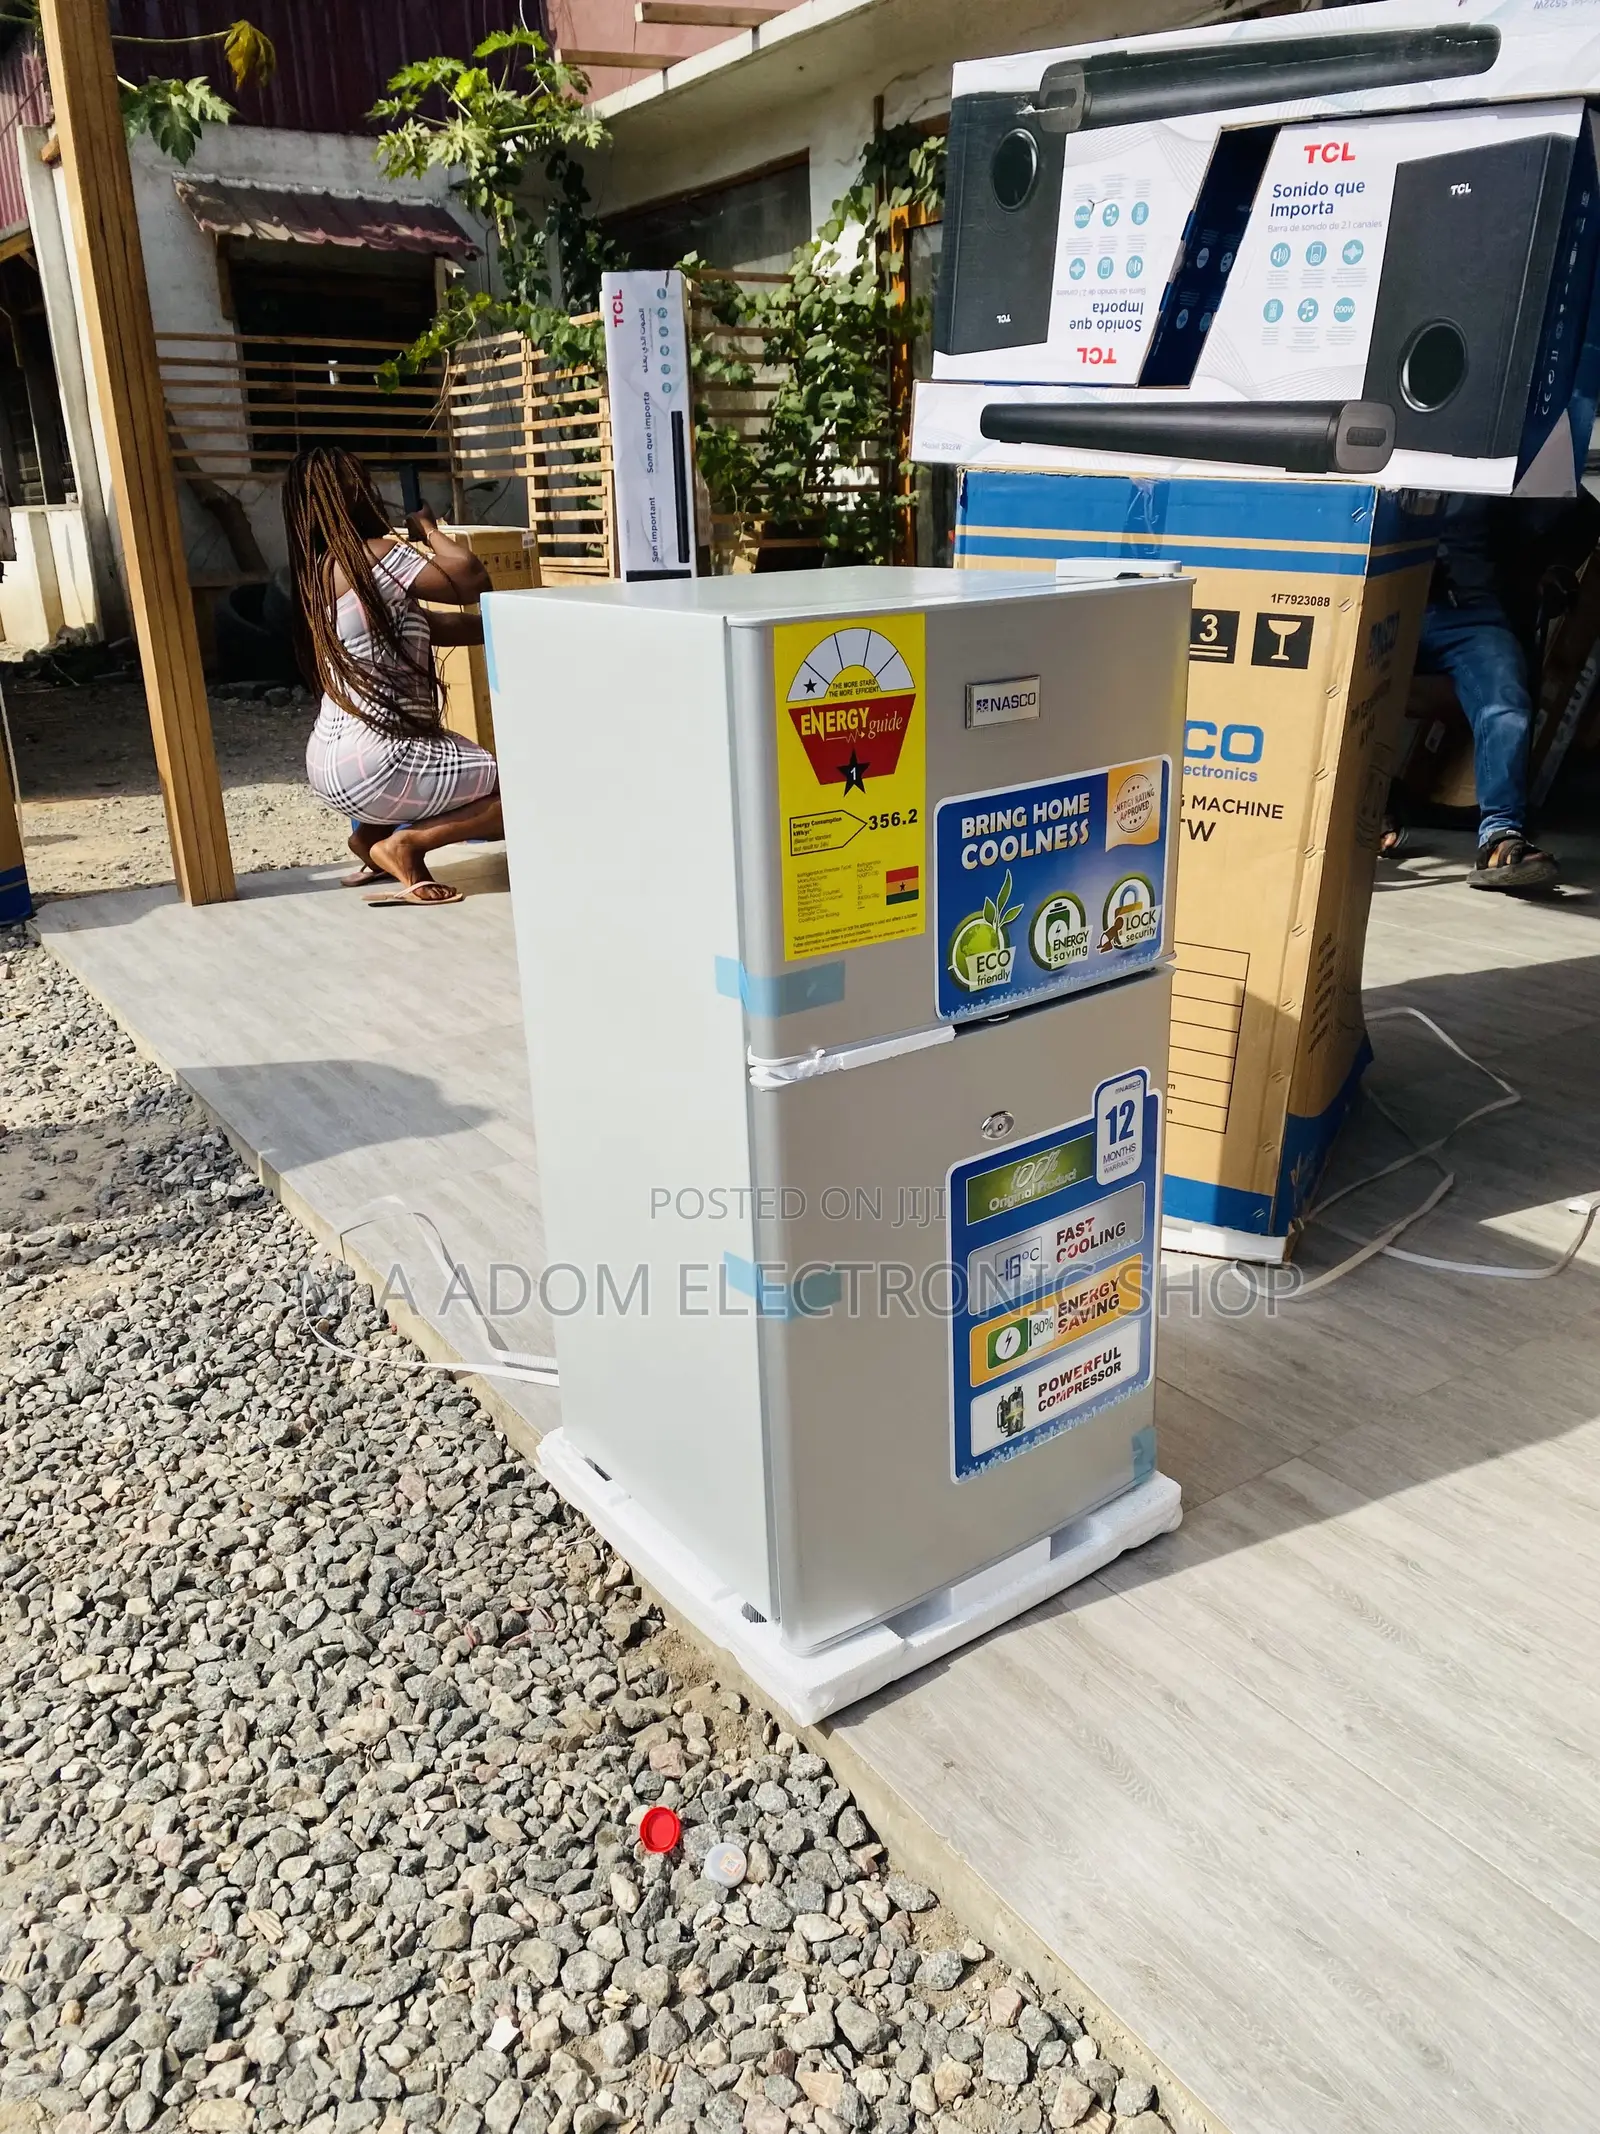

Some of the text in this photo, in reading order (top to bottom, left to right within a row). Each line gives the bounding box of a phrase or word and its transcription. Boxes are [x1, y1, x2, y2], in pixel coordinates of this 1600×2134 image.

[1303, 142, 1356, 164] TCL
[1272, 181, 1366, 198] Sonido que
[1450, 182, 1472, 196] TCL
[1270, 201, 1334, 219] Importa
[1267, 224, 1288, 233] Barra
[1289, 222, 1300, 232] de
[1301, 222, 1327, 231] sonido
[1352, 220, 1383, 229] canales
[613, 289, 624, 328] TCL
[1092, 301, 1144, 315] Importa
[1069, 318, 1142, 332] Sonido que
[1077, 347, 1117, 364] TCL
[645, 433, 653, 450] que
[649, 497, 658, 542] important
[1270, 593, 1331, 608] 1F7923088
[1199, 613, 1218, 642] 3
[829, 690, 839, 698] THE
[839, 689, 853, 697] MORE
[833, 679, 876, 690] THE MORE STARS
[990, 692, 1036, 712] NASCO
[800, 707, 903, 742] ENERGY guide
[850, 767, 857, 781] 1
[1134, 787, 1155, 803] RATING
[961, 792, 1090, 839] BRING HOME
[1120, 800, 1150, 821] APPROVED
[1191, 795, 1284, 820] MACHINE
[868, 808, 918, 830] 356.2
[961, 818, 1090, 870] COOLNESS
[1125, 910, 1157, 931] LOCK
[1053, 930, 1089, 951] ENERGY
[1125, 926, 1157, 943] security
[976, 949, 1011, 974] ECO
[1053, 944, 1088, 963] saving
[976, 969, 1010, 987] friendly
[1105, 1099, 1136, 1146] 12
[1103, 1143, 1137, 1164] MONTHS
[1011, 1149, 1062, 1190] 100%
[1103, 1156, 1136, 1174] WARRANTY
[989, 1168, 1077, 1212] Original Product
[1056, 1217, 1095, 1246] FAST
[1056, 1221, 1126, 1264] COOLING
[1058, 1277, 1120, 1318] ENERGY
[1058, 1293, 1120, 1335] SAVING
[1033, 1316, 1054, 1336] 30%
[1038, 1346, 1122, 1398] POWERFUL
[1038, 1361, 1122, 1412] COMPRESSOR
